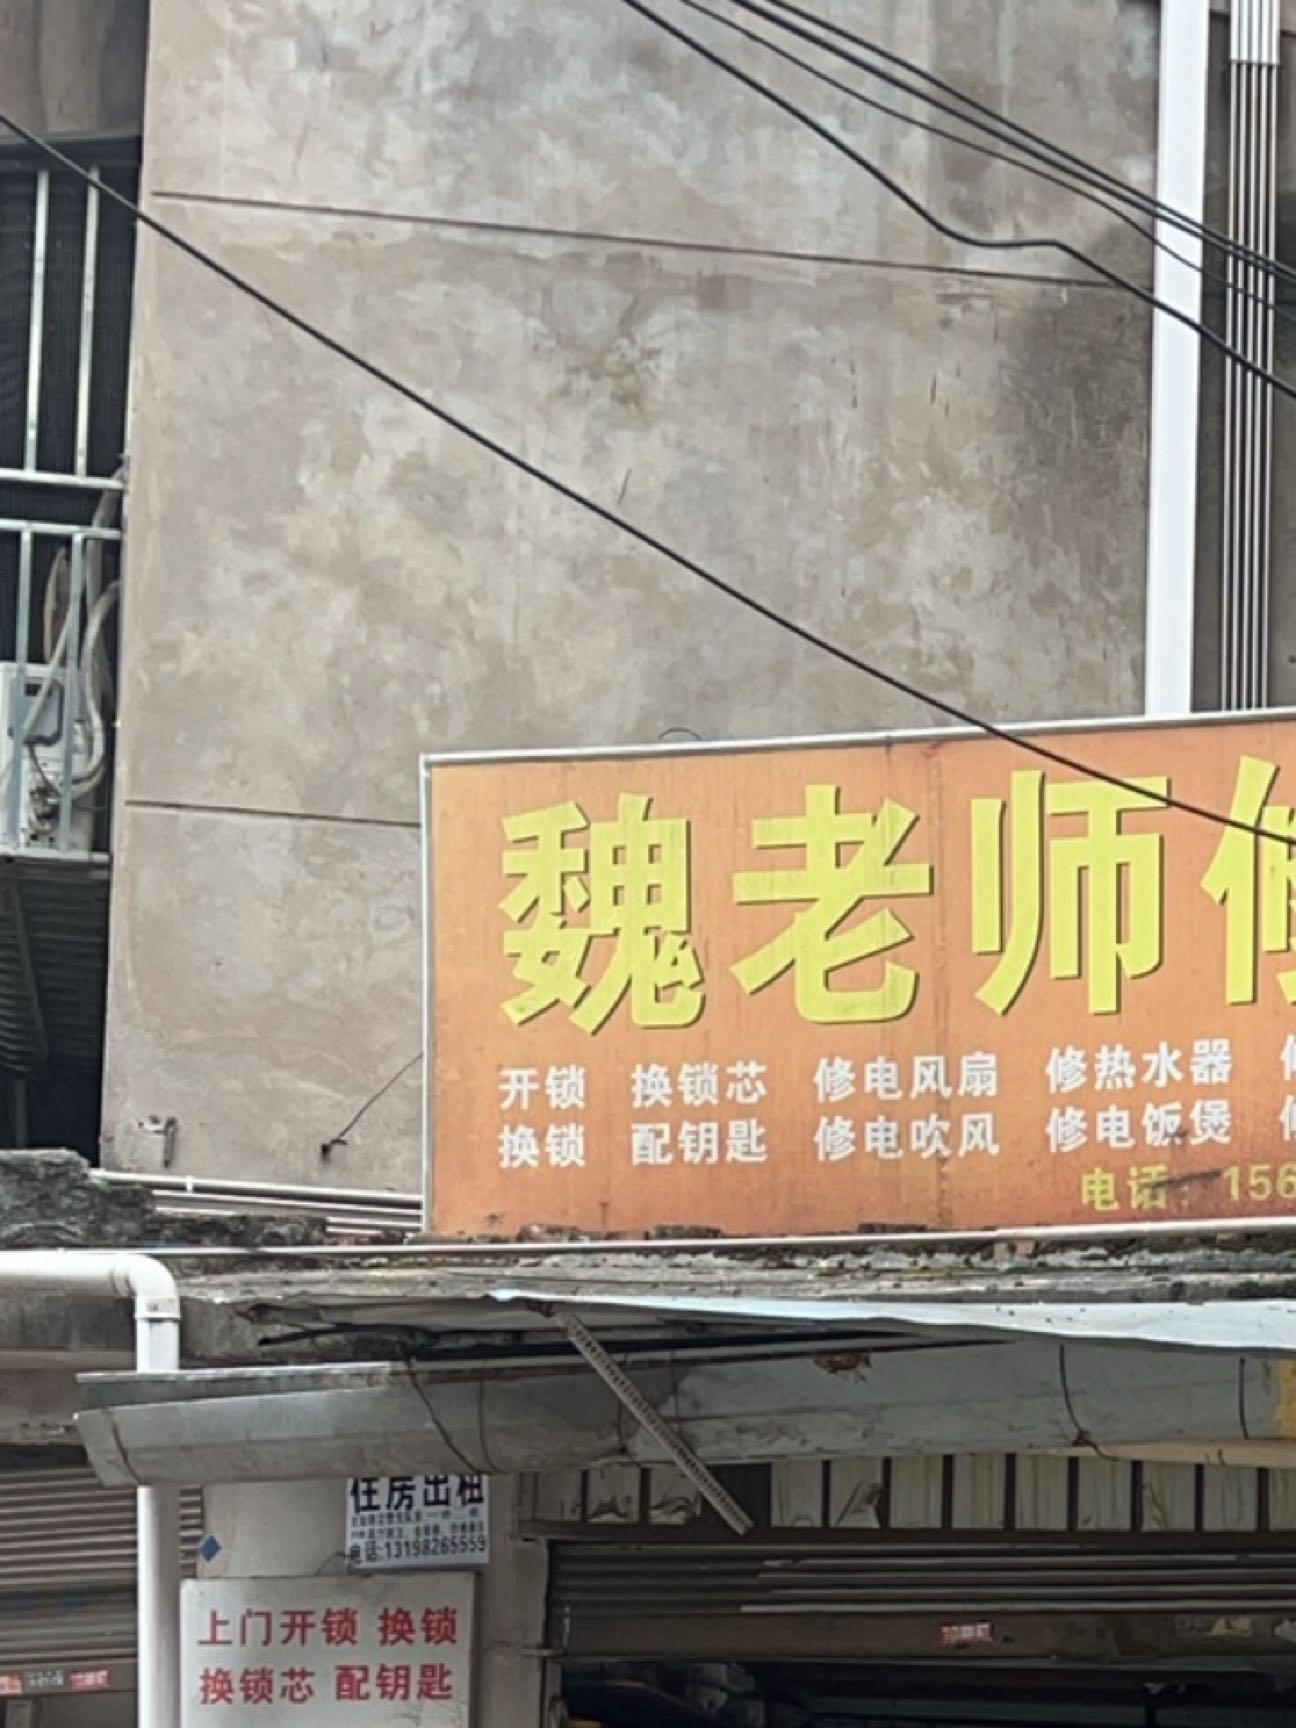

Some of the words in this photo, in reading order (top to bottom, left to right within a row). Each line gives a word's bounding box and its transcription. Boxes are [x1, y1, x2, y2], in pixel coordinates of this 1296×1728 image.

[498, 1067, 587, 1111] 开锁
[631, 1062, 767, 1107] 换锁芯
[813, 1051, 1000, 1102] 修电风扇
[1045, 1039, 1233, 1095] 修热水器
[498, 1125, 587, 1169] 换锁
[631, 1121, 768, 1166] 配钥匙
[813, 1113, 1000, 1162] 修电吹风
[1045, 1099, 1233, 1154] 修电饭煲
[196, 1607, 359, 1648] 上门开锁
[378, 1606, 458, 1646] 换锁
[199, 1666, 316, 1705] 换锁芯
[335, 1663, 455, 1703] 配钥匙
